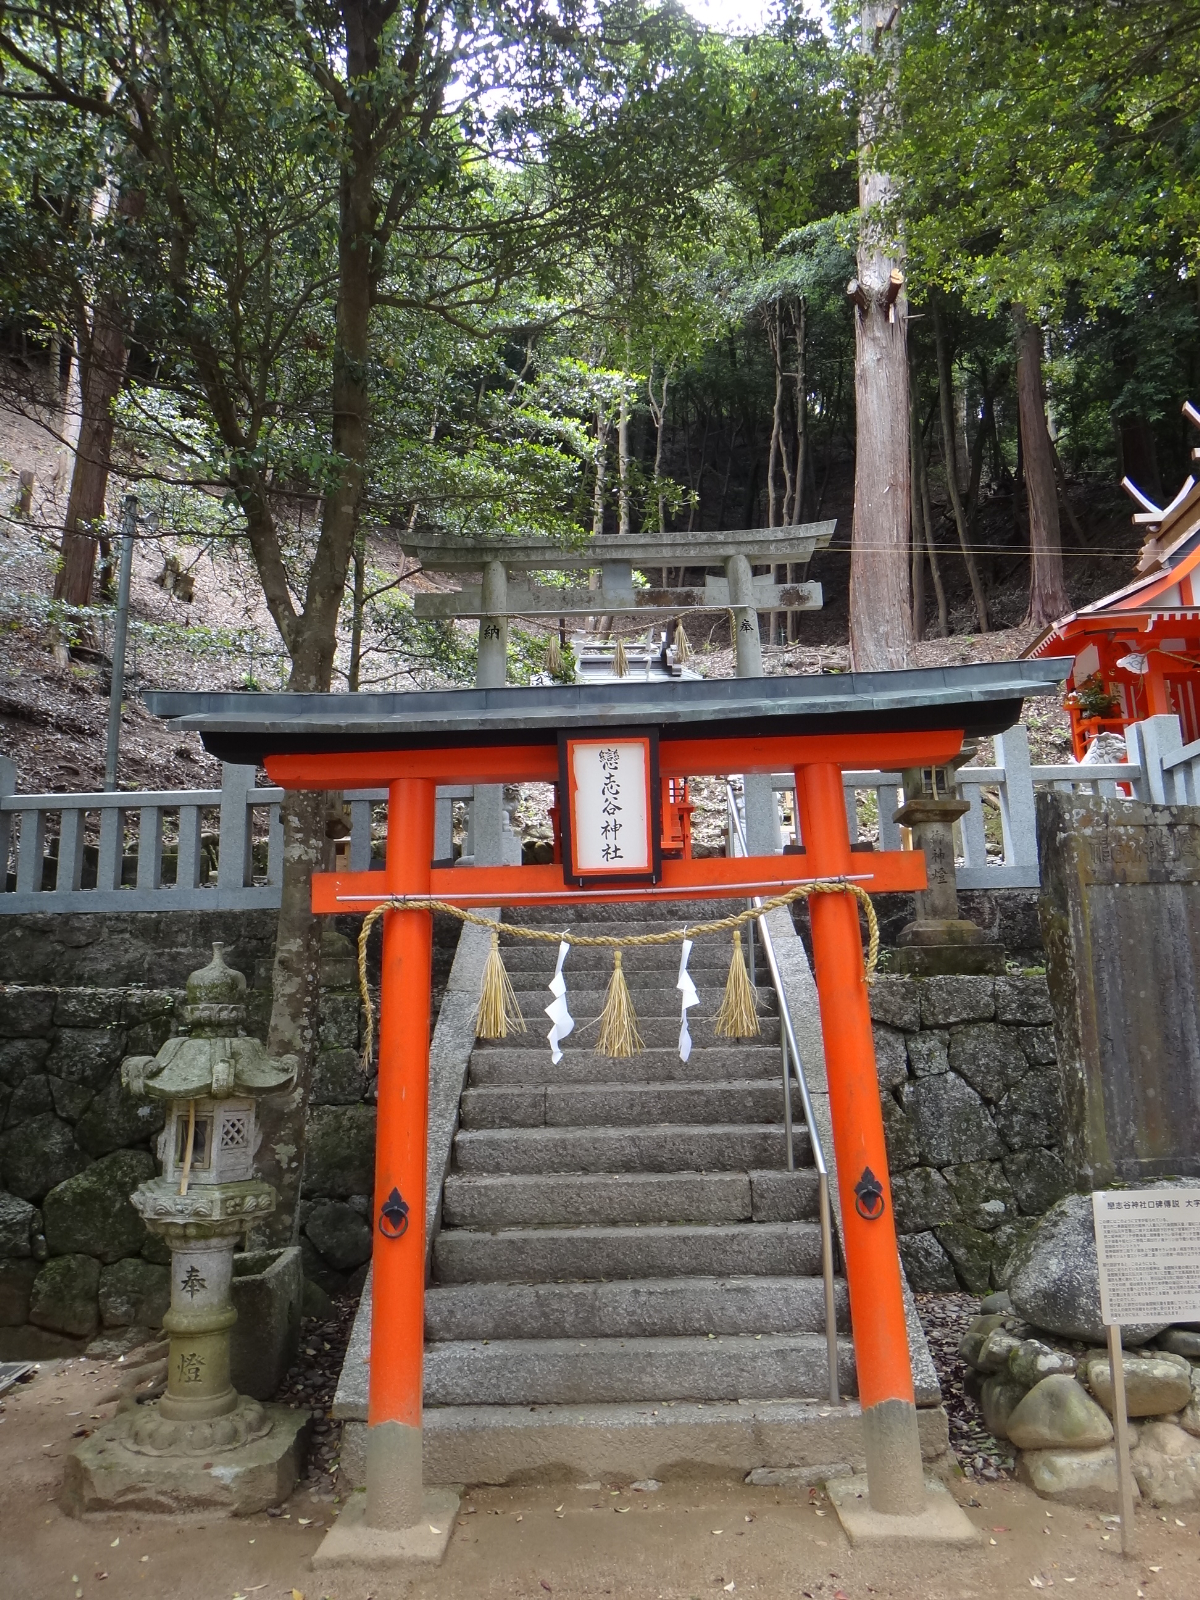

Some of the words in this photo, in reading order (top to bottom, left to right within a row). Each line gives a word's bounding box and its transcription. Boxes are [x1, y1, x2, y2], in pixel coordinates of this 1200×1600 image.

[484, 625, 500, 640] 納
[739, 619, 754, 633] 奉
[599, 749, 623, 862] 戀志谷神社
